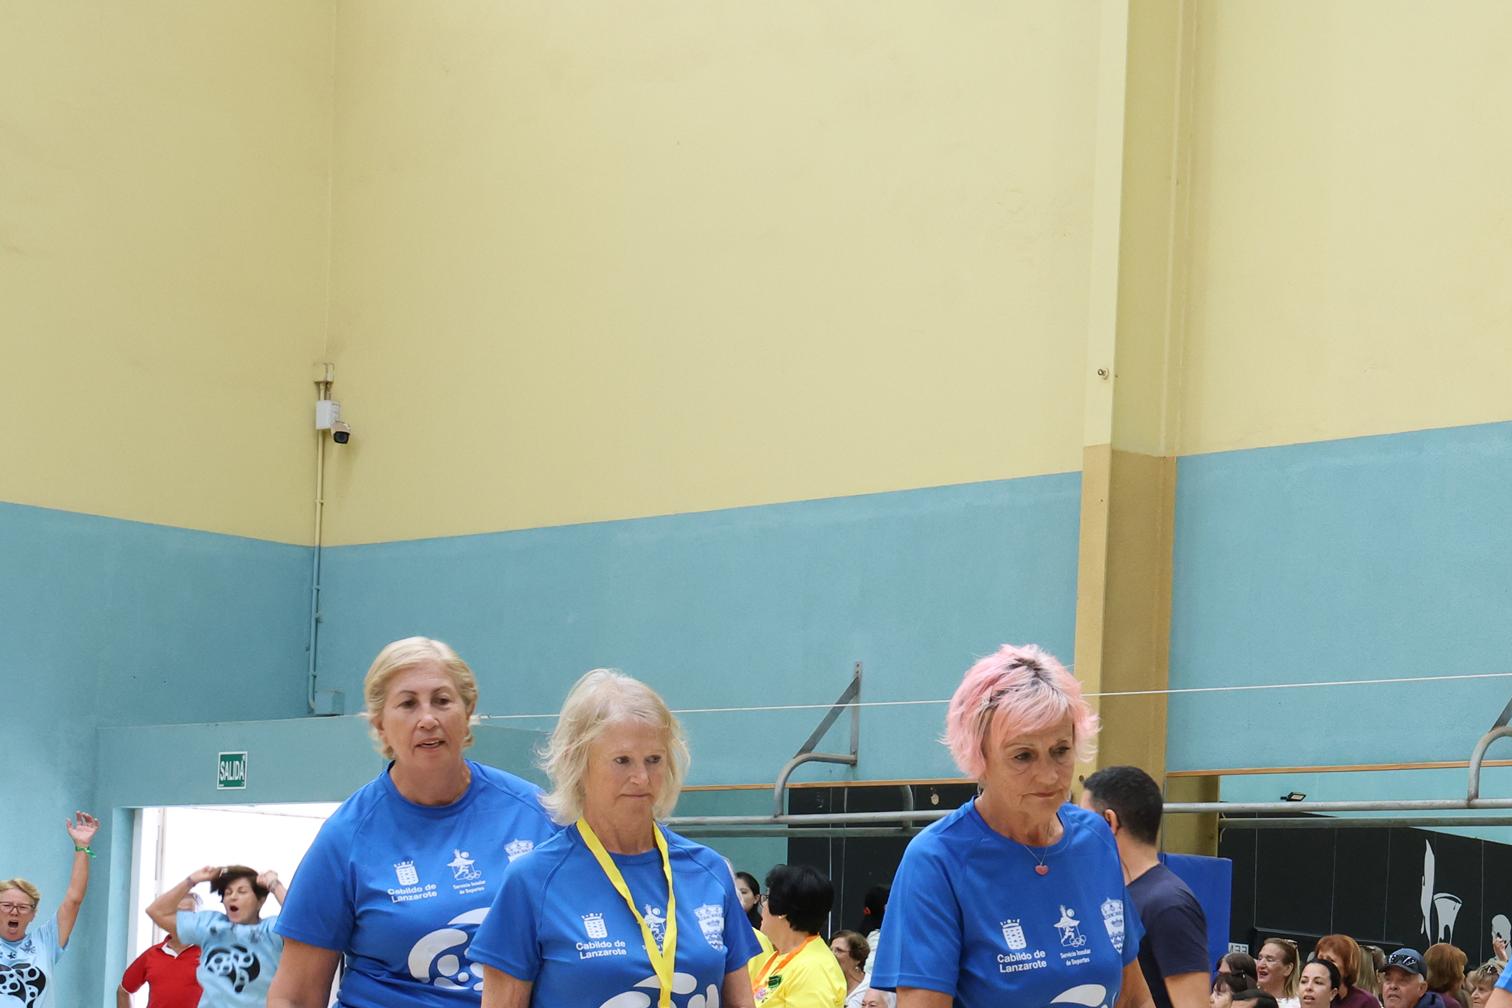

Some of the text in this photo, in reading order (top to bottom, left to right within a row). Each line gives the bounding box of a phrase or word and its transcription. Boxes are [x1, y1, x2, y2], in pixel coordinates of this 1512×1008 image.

[220, 760, 245, 781] SALIDA
[388, 886, 422, 895] Cabildo
[392, 891, 437, 903] Lanzarote
[576, 940, 626, 951] Cabildo de
[580, 948, 626, 960] Lanzarote
[997, 949, 1046, 964] Cabildo de
[1000, 960, 1048, 974] Lanzarote
